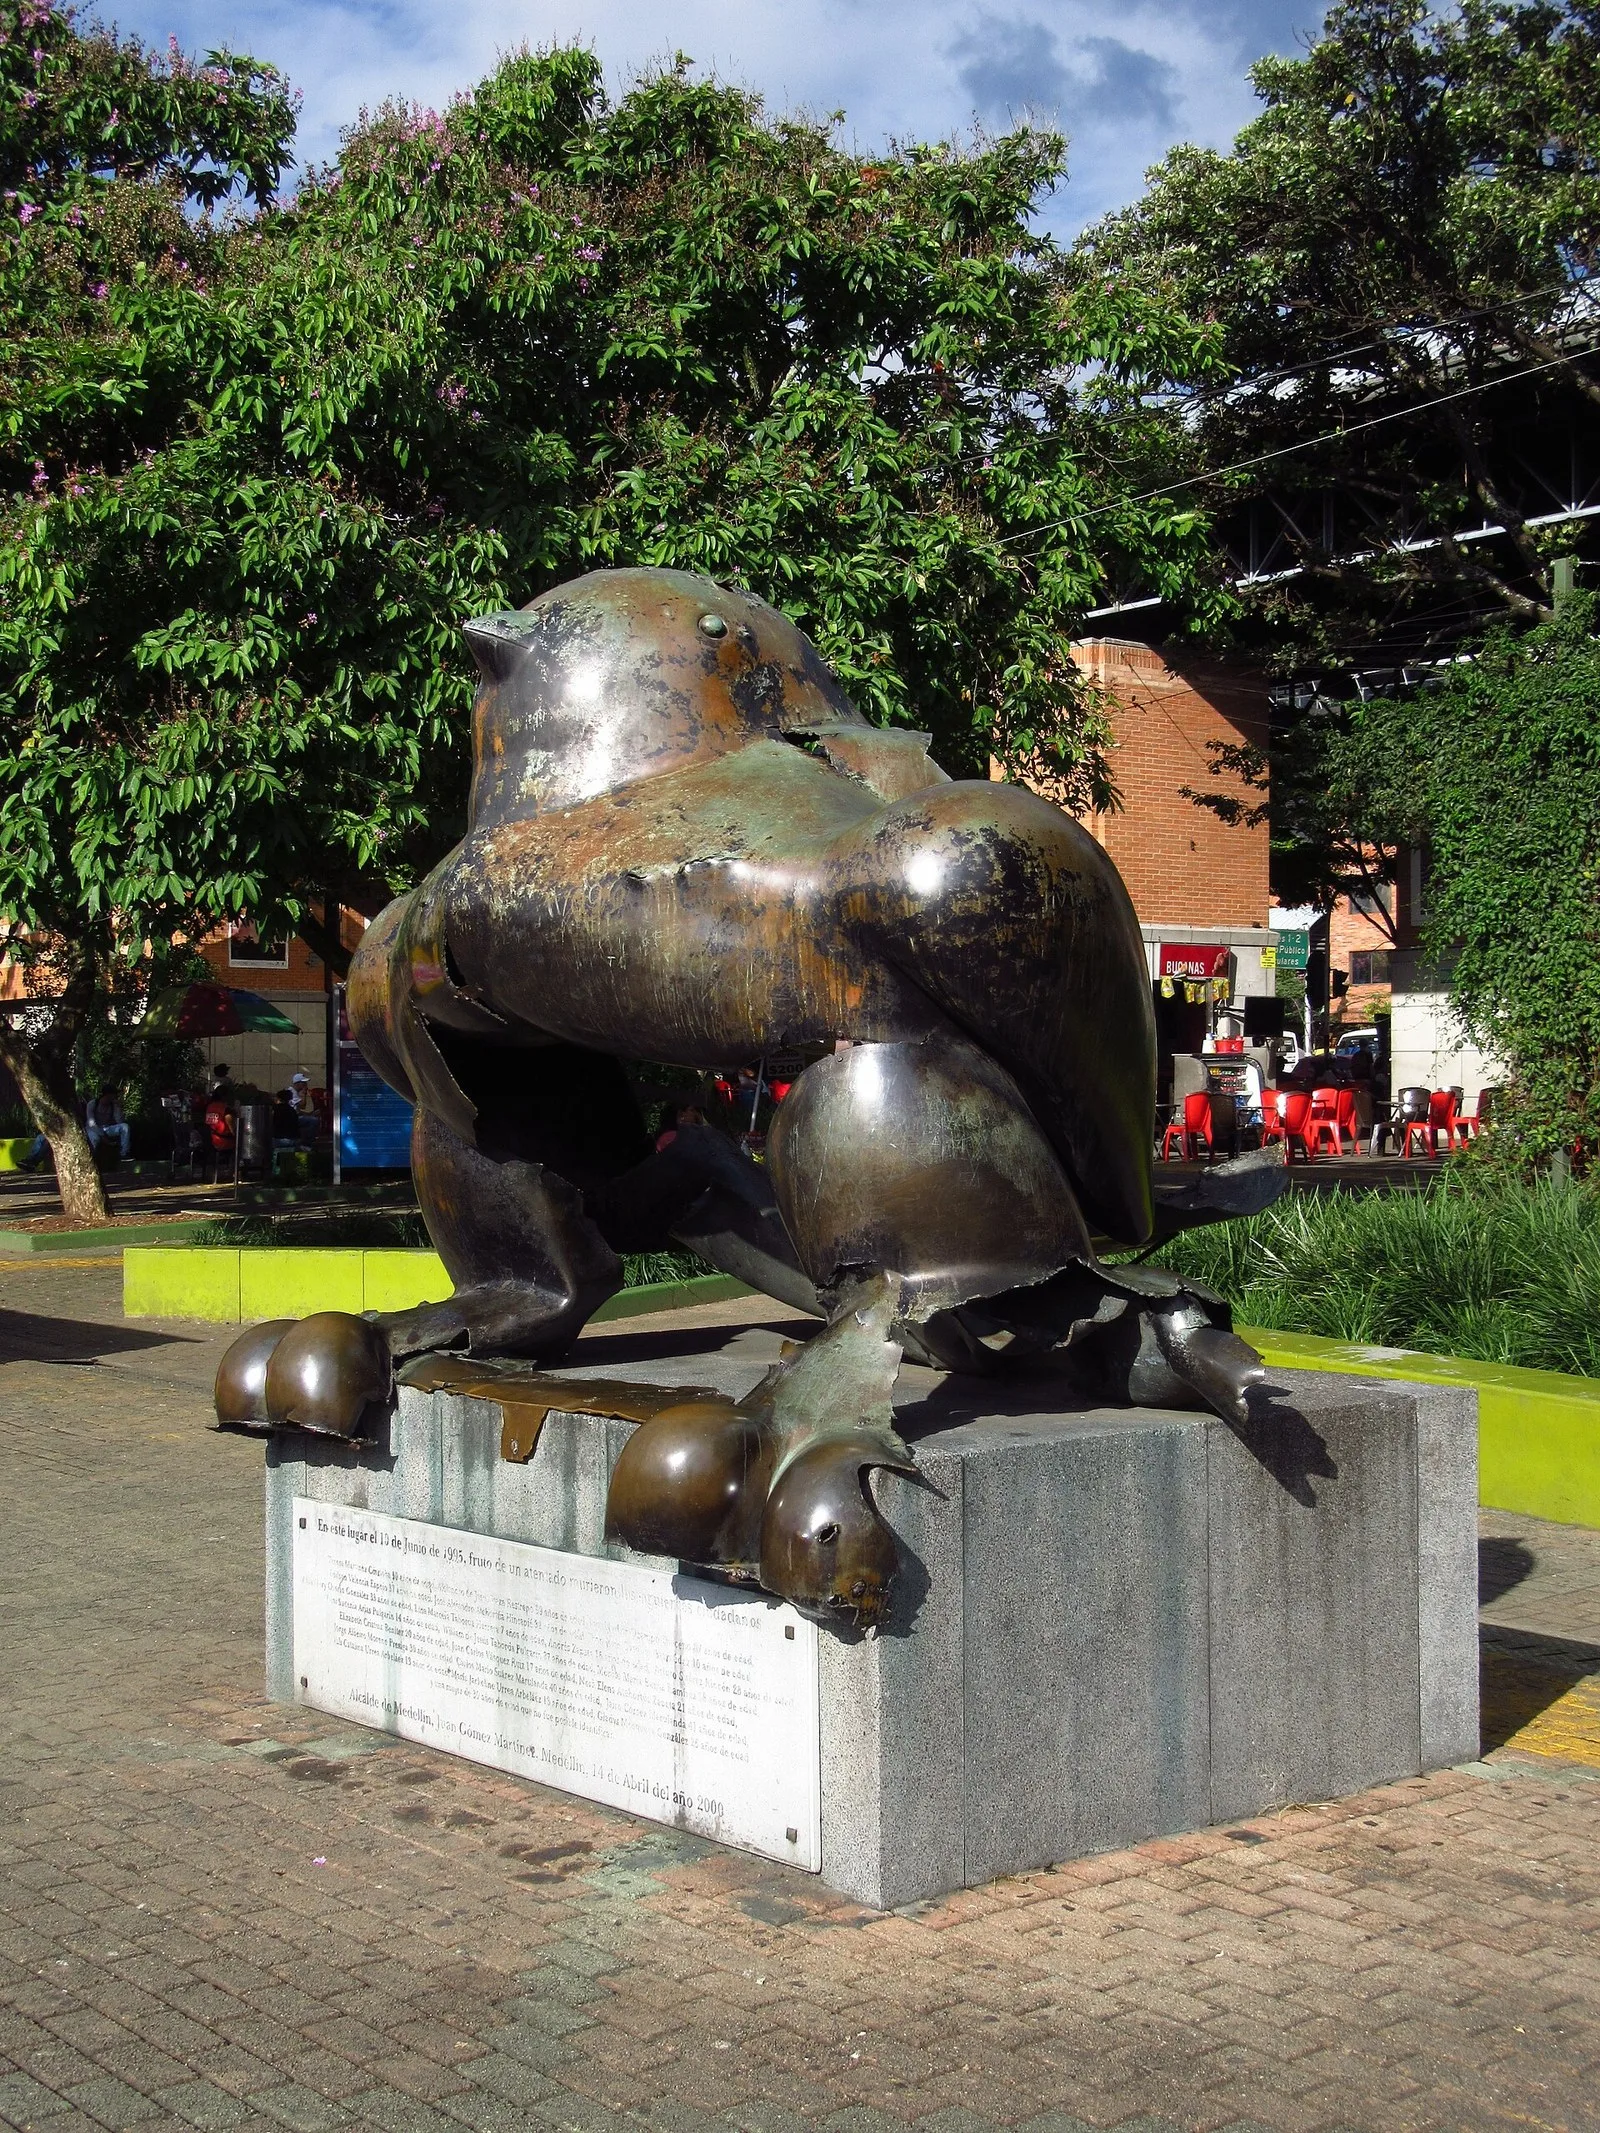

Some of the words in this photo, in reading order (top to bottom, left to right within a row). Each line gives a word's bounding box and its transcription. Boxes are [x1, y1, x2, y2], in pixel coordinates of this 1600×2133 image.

[317, 1518, 328, 1534] En
[330, 1522, 345, 1538] este
[347, 1524, 367, 1544] lugar
[369, 1530, 377, 1545] el
[391, 1533, 401, 1550] de
[403, 1536, 426, 1556] Junio
[429, 1542, 439, 1559] de
[468, 1550, 491, 1570] fruto
[494, 1556, 506, 1574] de
[509, 1563, 520, 1577] un
[349, 1686, 378, 1709] Alcalde
[381, 1696, 391, 1713] de
[459, 1721, 490, 1745] Gómez
[622, 1771, 648, 1795] Abril
[652, 1781, 668, 1801] del
[672, 1789, 692, 1809] año
[697, 1795, 723, 1819] 2000
